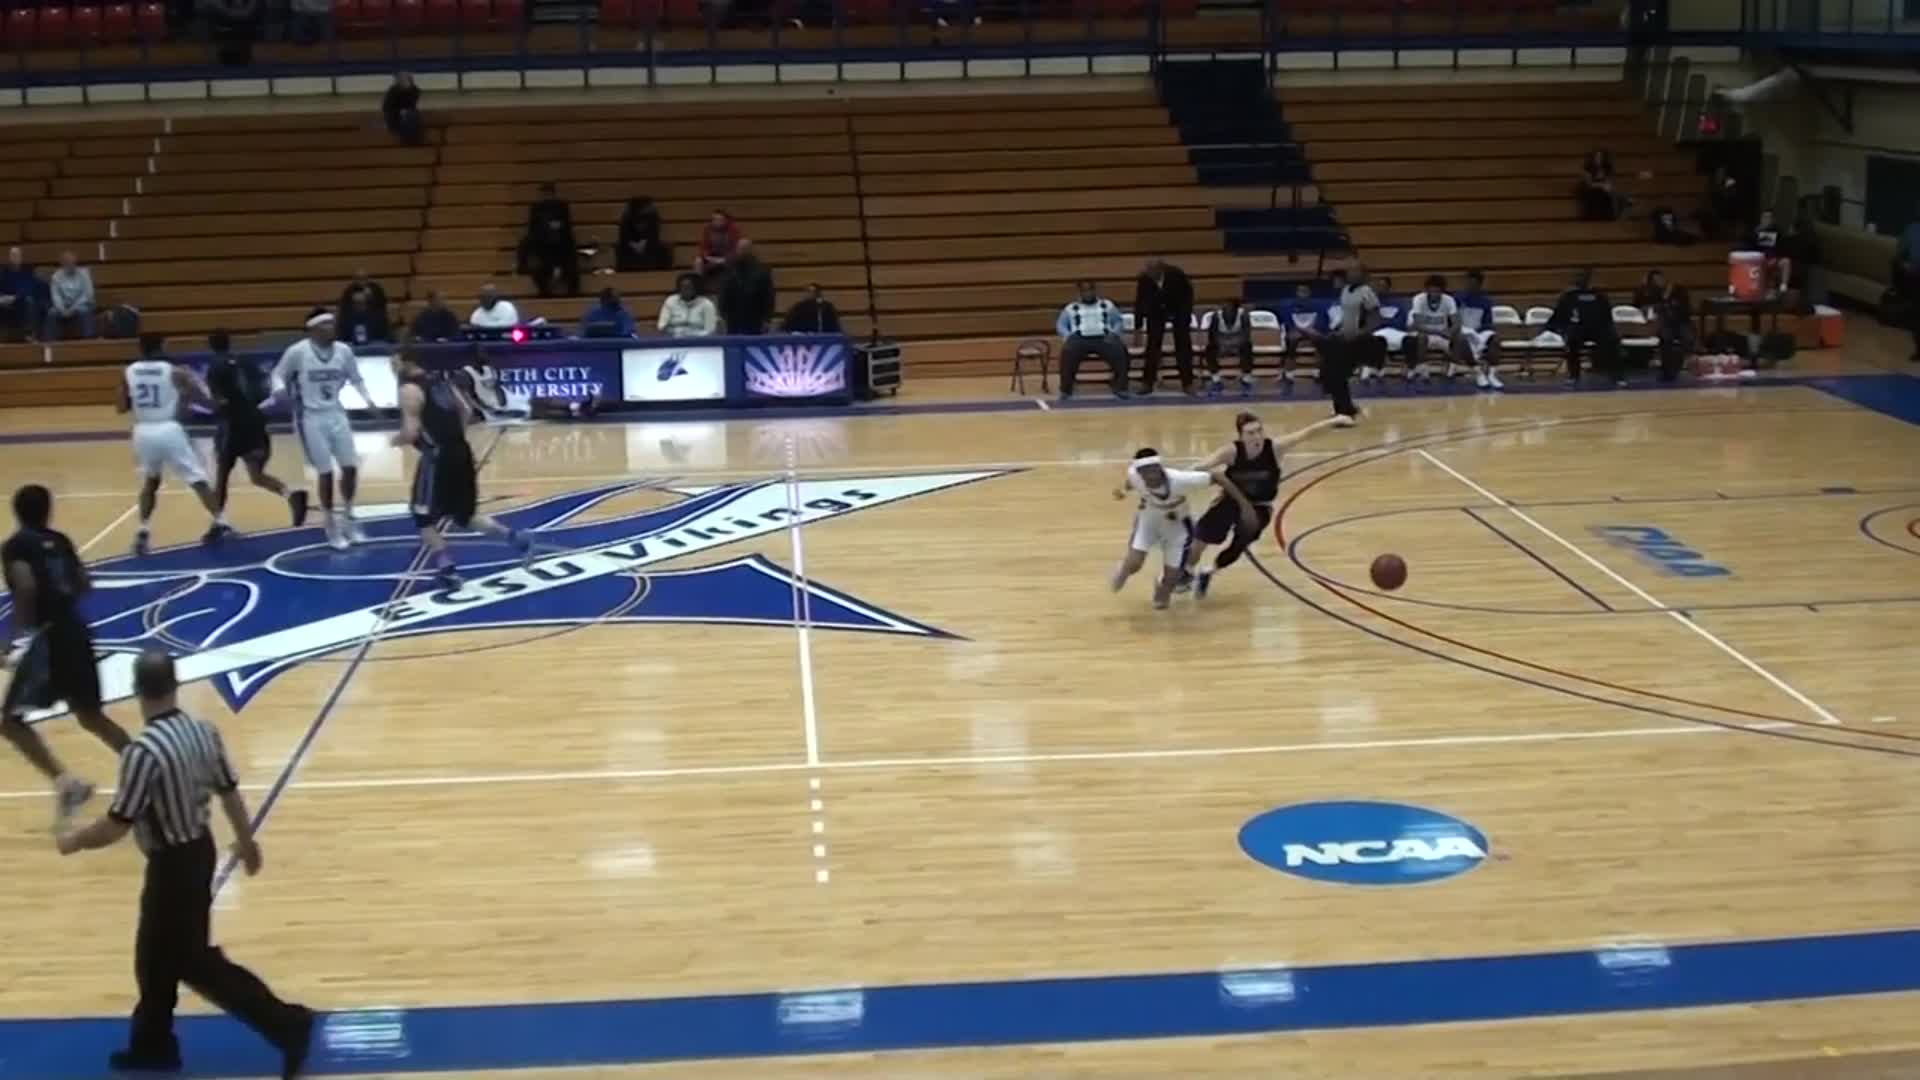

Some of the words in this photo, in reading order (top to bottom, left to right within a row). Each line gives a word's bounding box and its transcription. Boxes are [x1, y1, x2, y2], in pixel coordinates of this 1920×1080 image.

[544, 366, 592, 382] CITY
[136, 384, 162, 409] 21
[370, 561, 585, 622] ECSU
[601, 488, 877, 560] Vikings
[1282, 837, 1486, 867] NCAA
